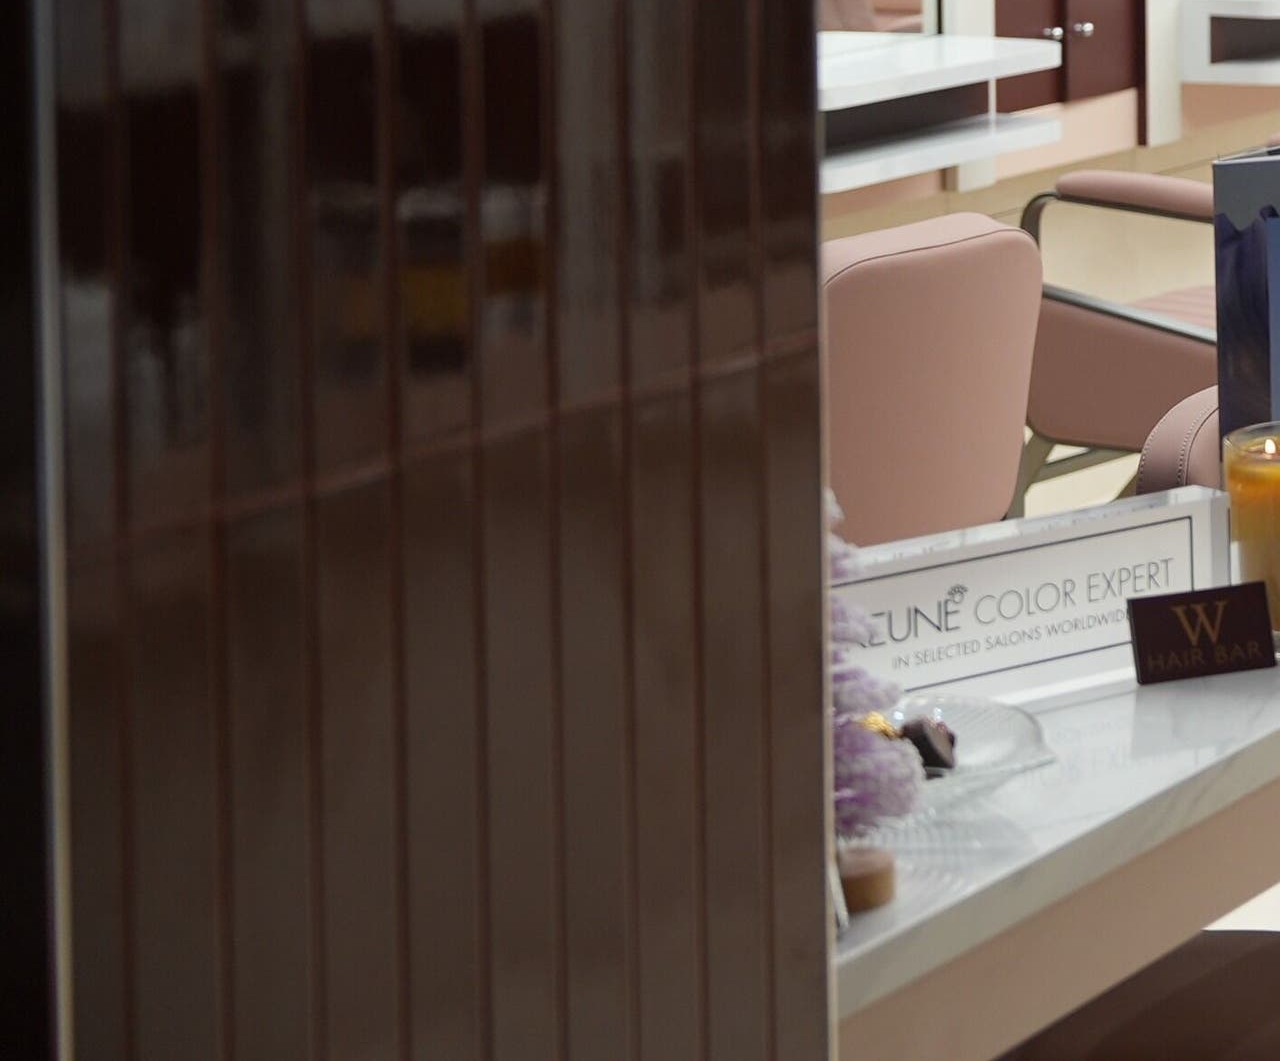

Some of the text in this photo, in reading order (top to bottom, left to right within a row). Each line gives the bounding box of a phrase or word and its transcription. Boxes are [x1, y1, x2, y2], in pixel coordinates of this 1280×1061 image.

[973, 578, 1077, 625] COLOR
[1086, 557, 1174, 603] EXPERT
[892, 608, 1130, 670] IN SELECTED SALONS WORLDWID
[1171, 600, 1228, 646] W
[1147, 641, 1264, 672] HAIR BAR
